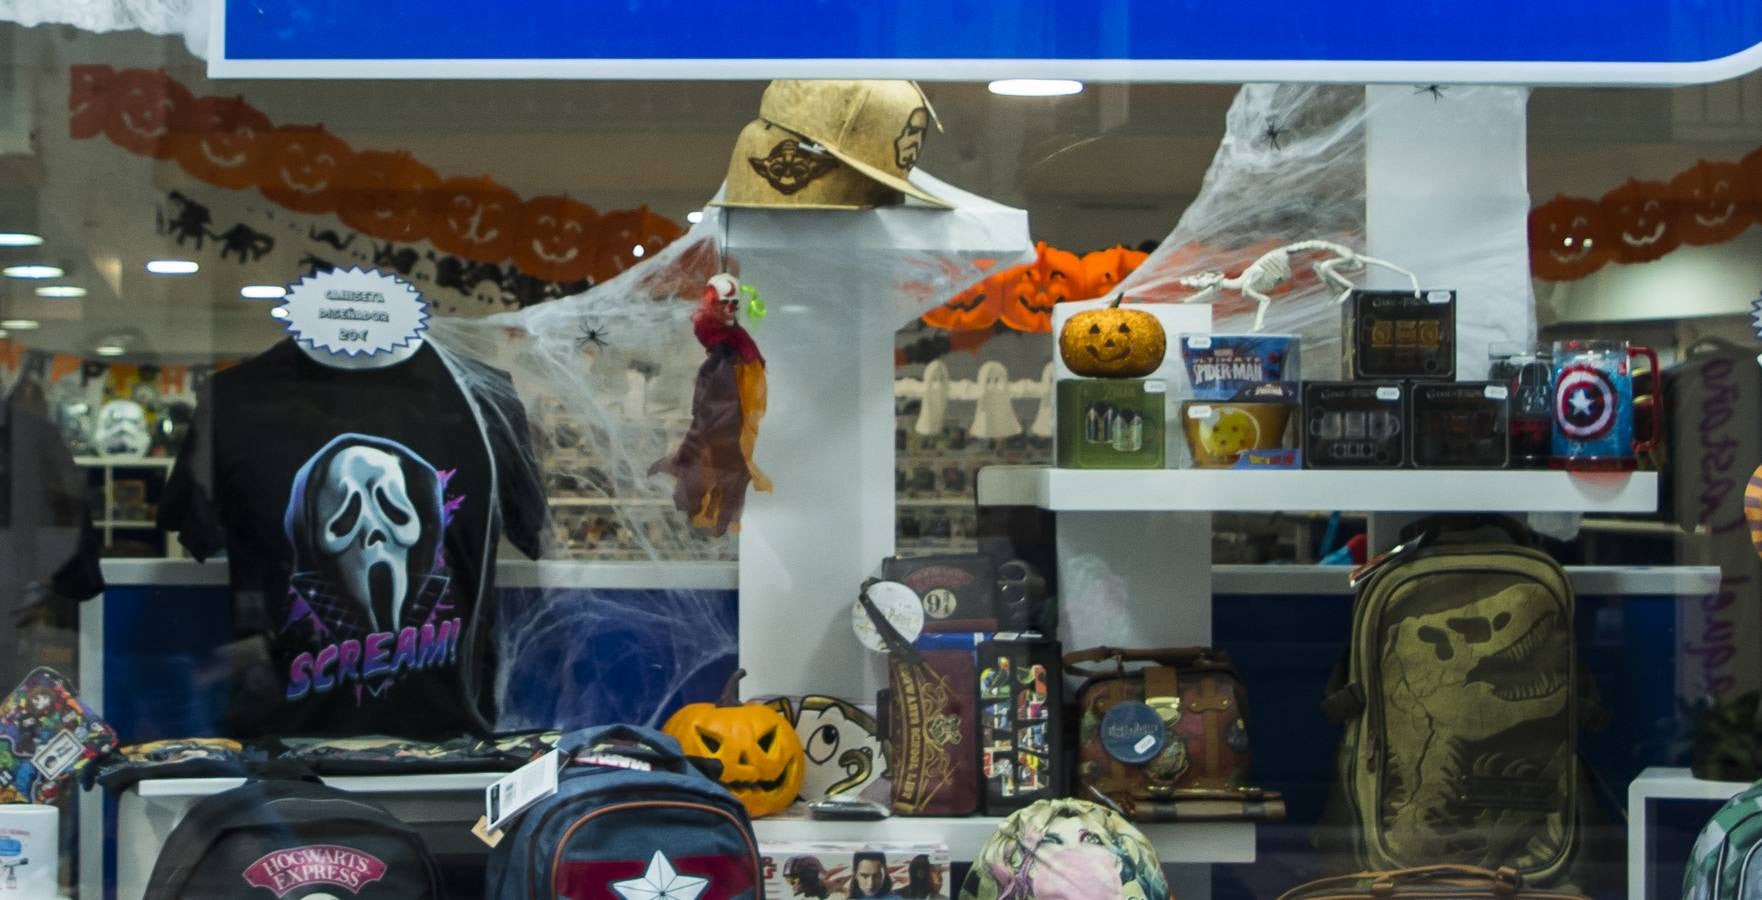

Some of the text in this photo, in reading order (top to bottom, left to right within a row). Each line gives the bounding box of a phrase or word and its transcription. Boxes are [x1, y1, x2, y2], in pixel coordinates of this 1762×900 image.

[1193, 363, 1263, 385] SPIDER-MAN
[286, 617, 461, 700] SCREAM!
[262, 849, 370, 876] HOGWARTS
[273, 864, 360, 890] EXPRESS
